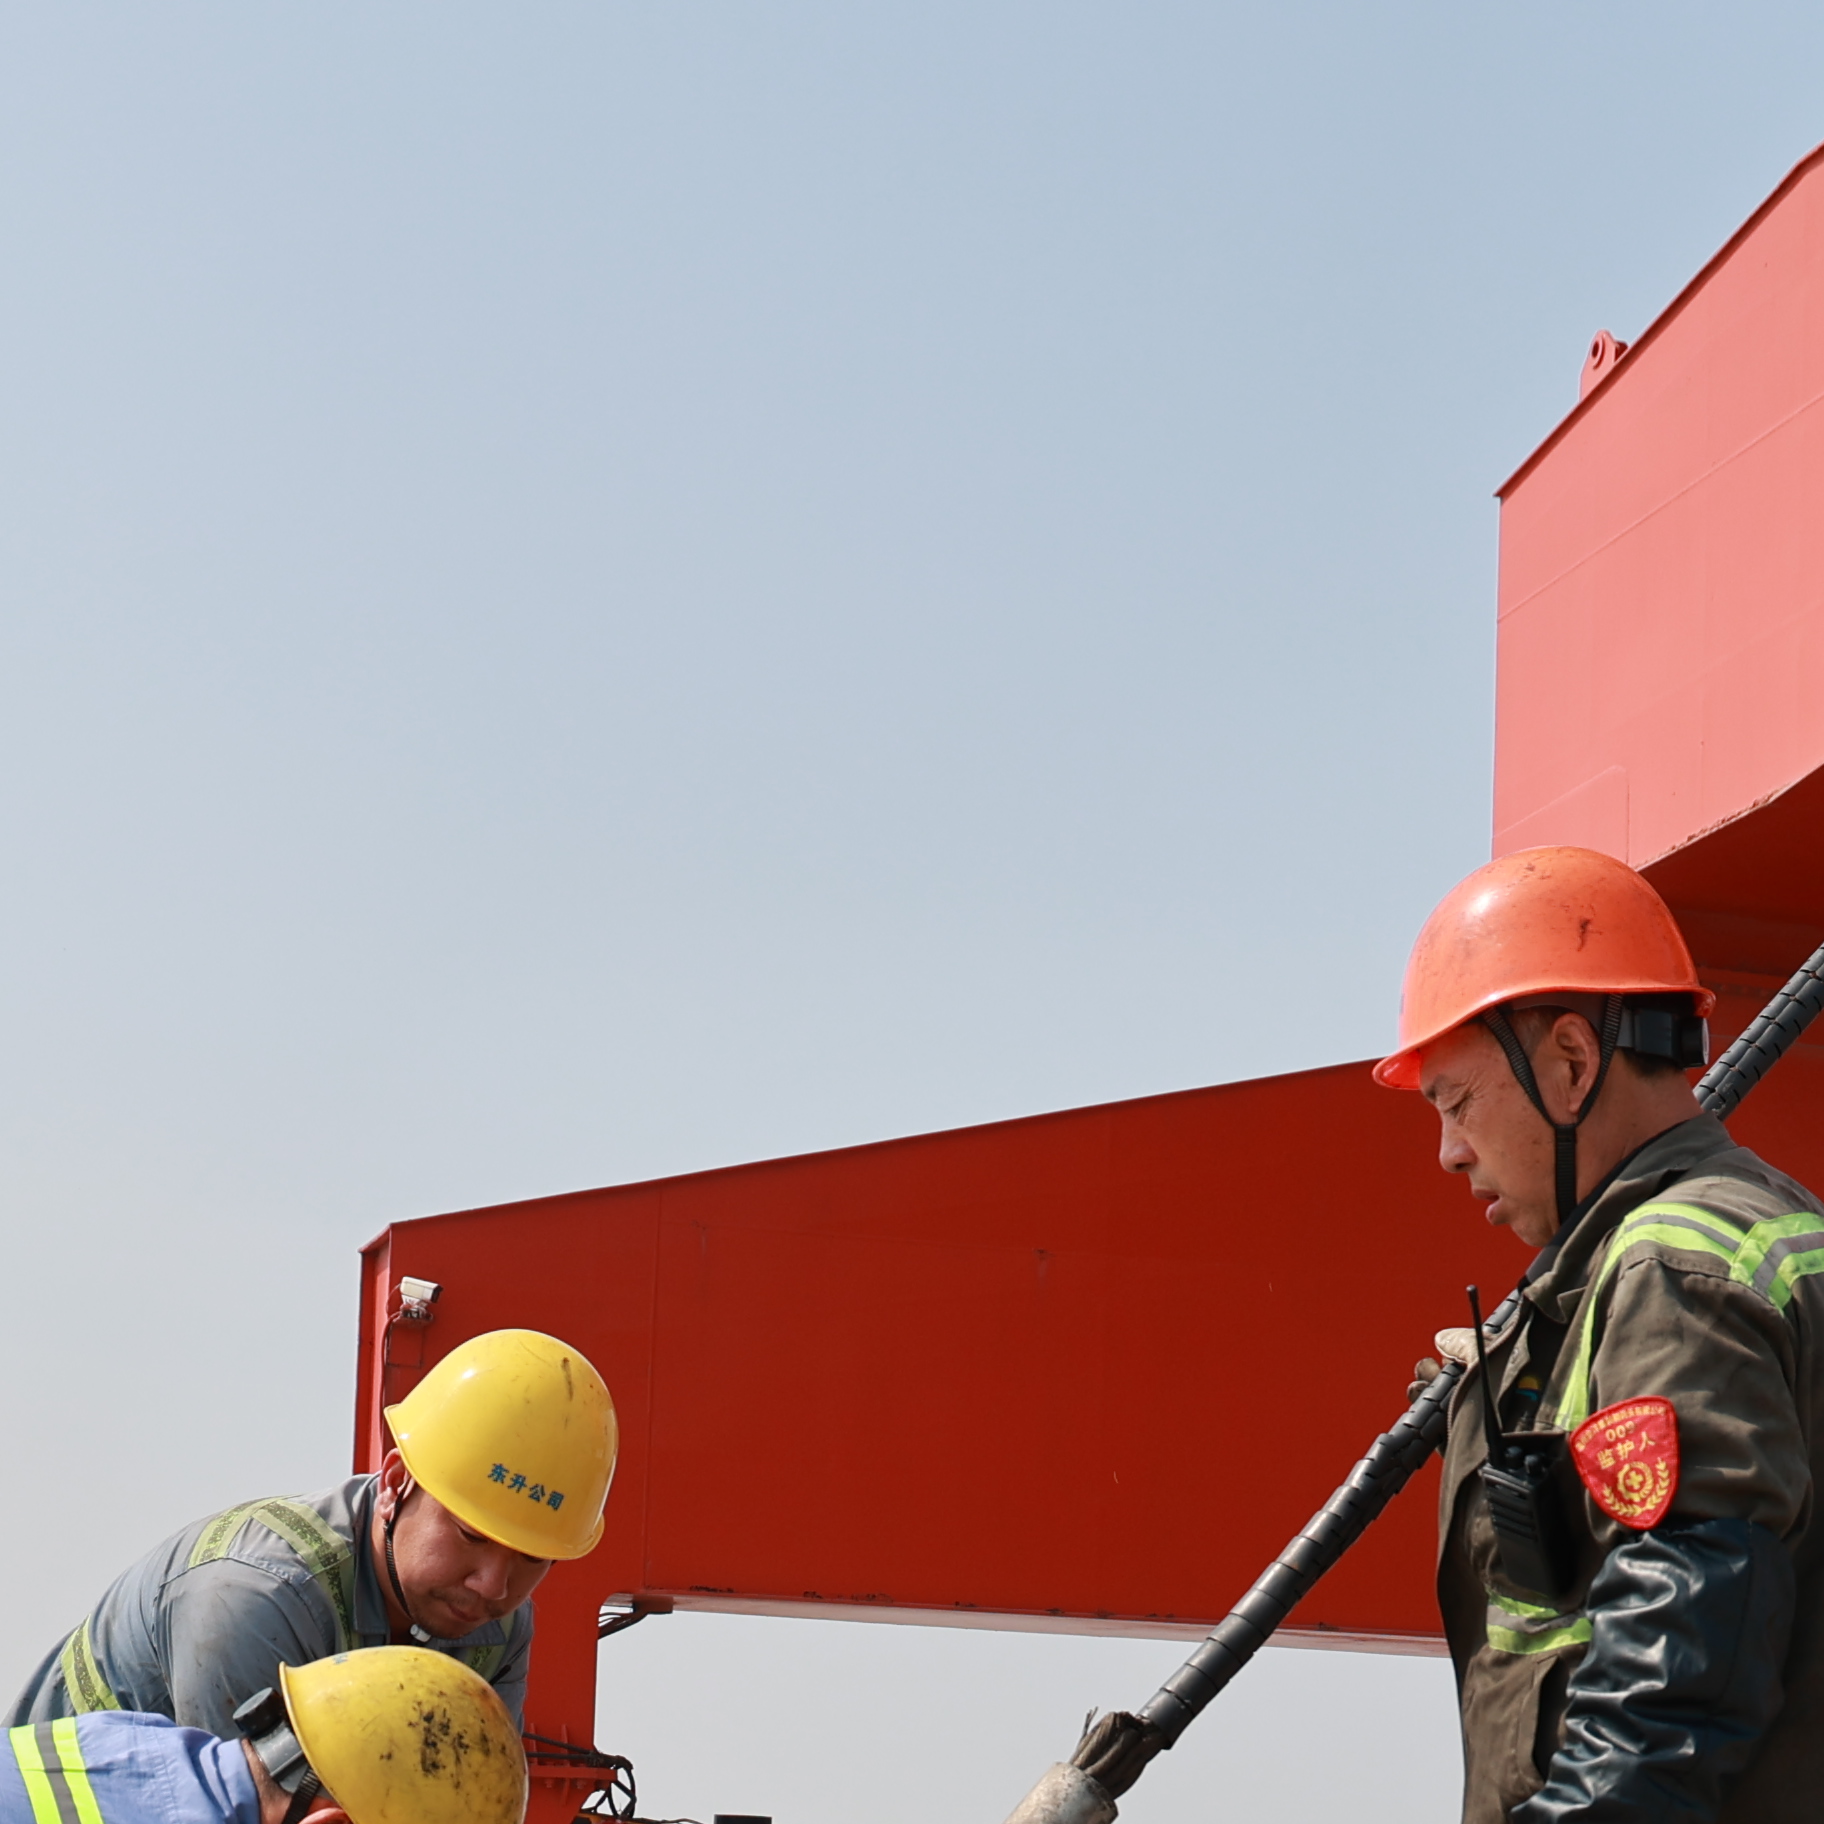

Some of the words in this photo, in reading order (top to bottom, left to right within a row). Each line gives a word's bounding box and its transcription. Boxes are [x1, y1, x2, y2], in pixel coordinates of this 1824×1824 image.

[1597, 1431, 1656, 1470] 监护人
[487, 1463, 564, 1511] 东升公司
